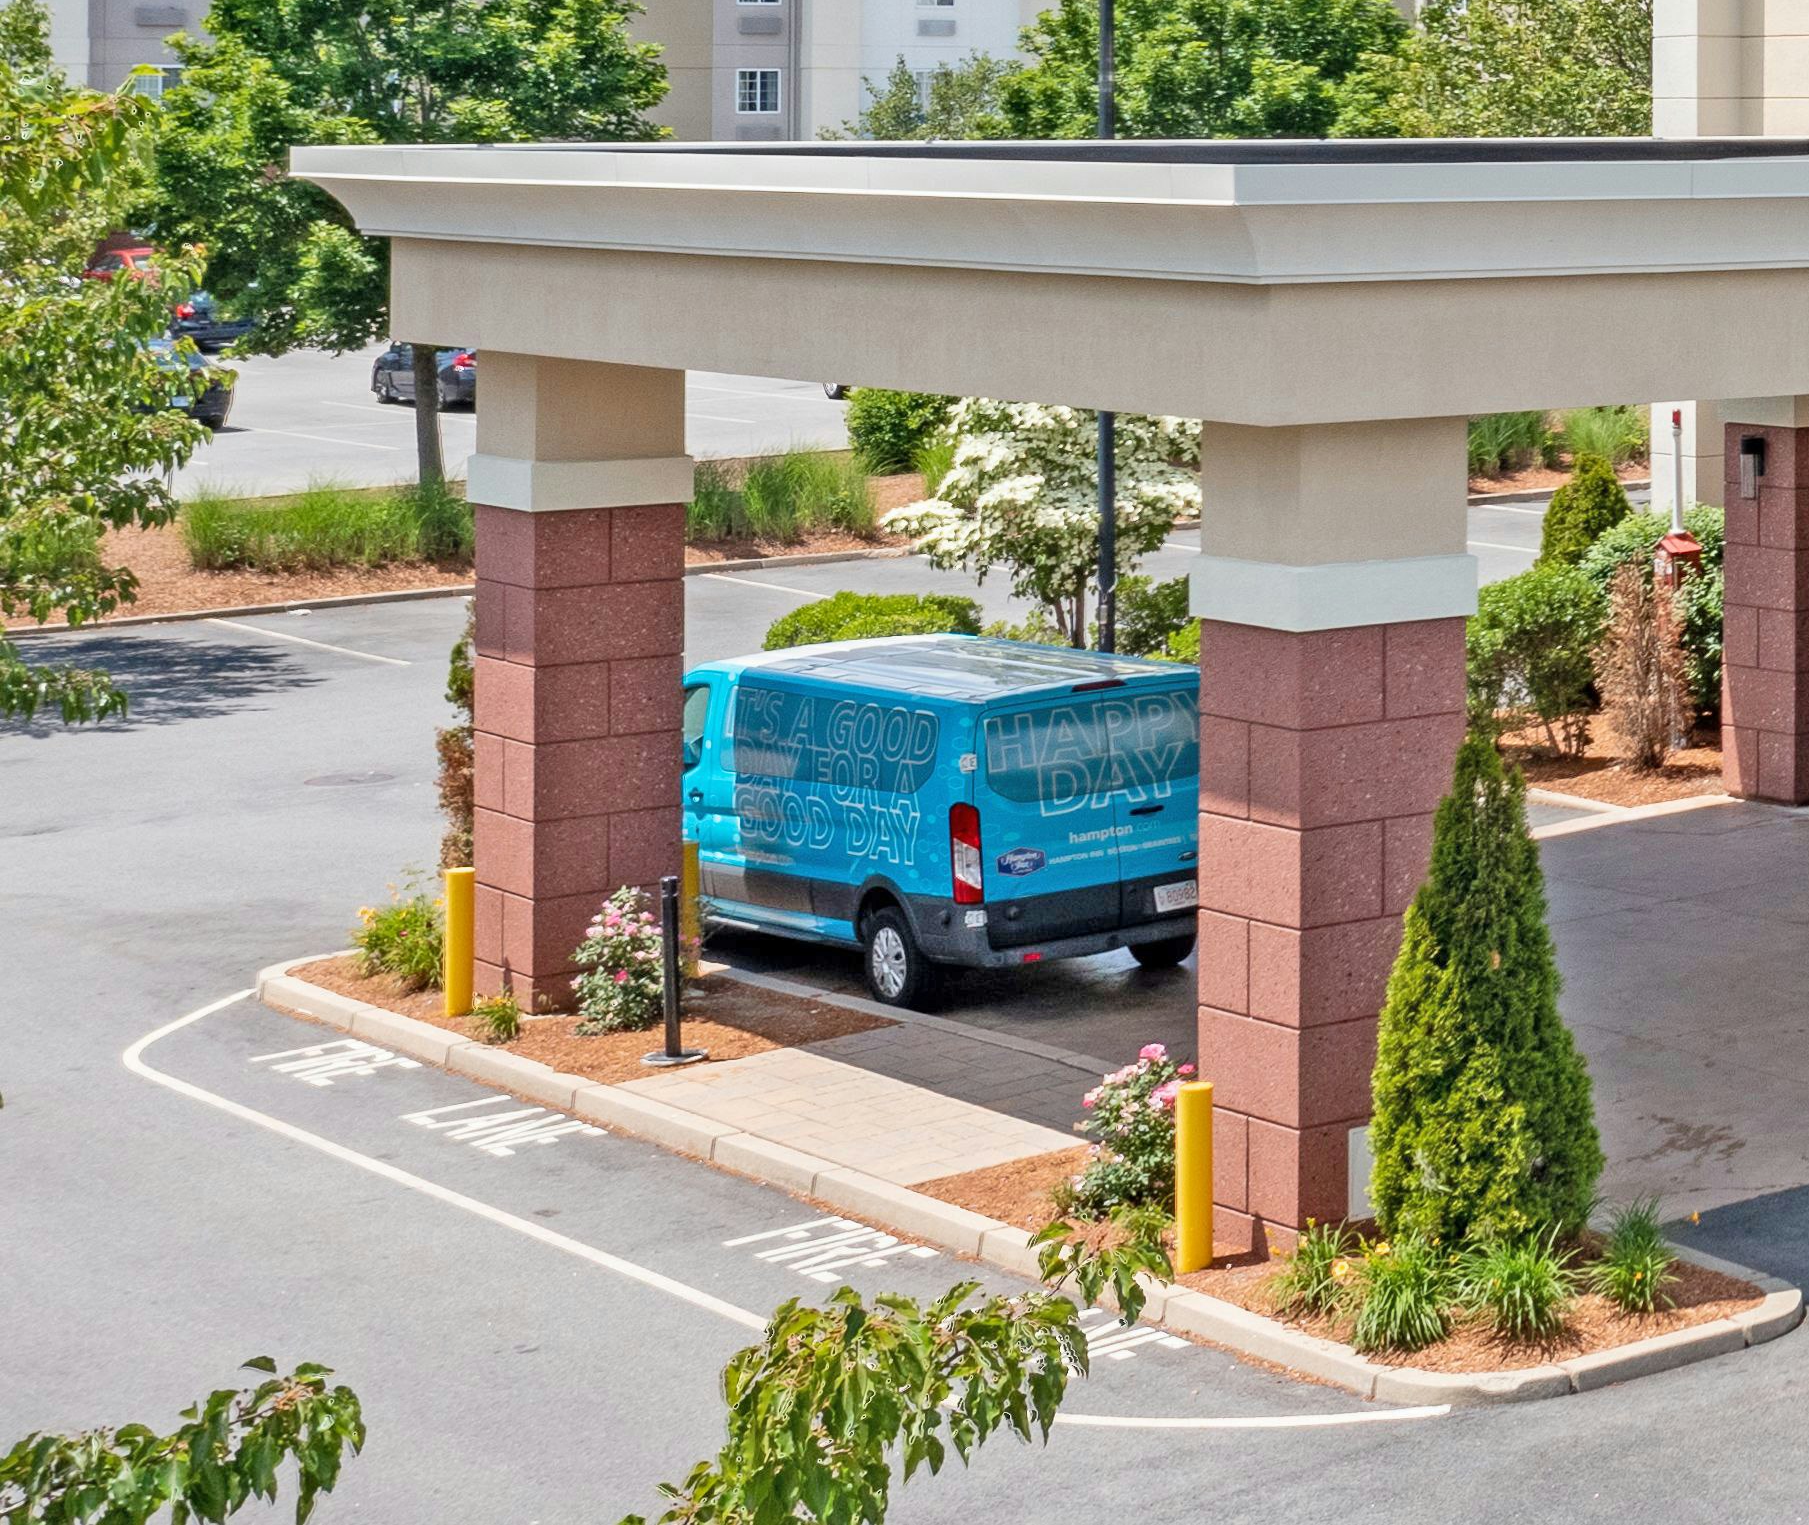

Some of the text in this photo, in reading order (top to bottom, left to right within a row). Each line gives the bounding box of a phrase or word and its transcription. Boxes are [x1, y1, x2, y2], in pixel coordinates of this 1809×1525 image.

[788, 697, 814, 748] A
[827, 700, 939, 765] GOOD
[811, 747, 880, 810] FOR
[890, 760, 920, 816] A
[1038, 741, 1184, 817] DAY
[735, 786, 920, 865] GOOD DAY
[250, 1038, 609, 1157] FIRE LANE
[721, 1215, 941, 1283] FIRE
